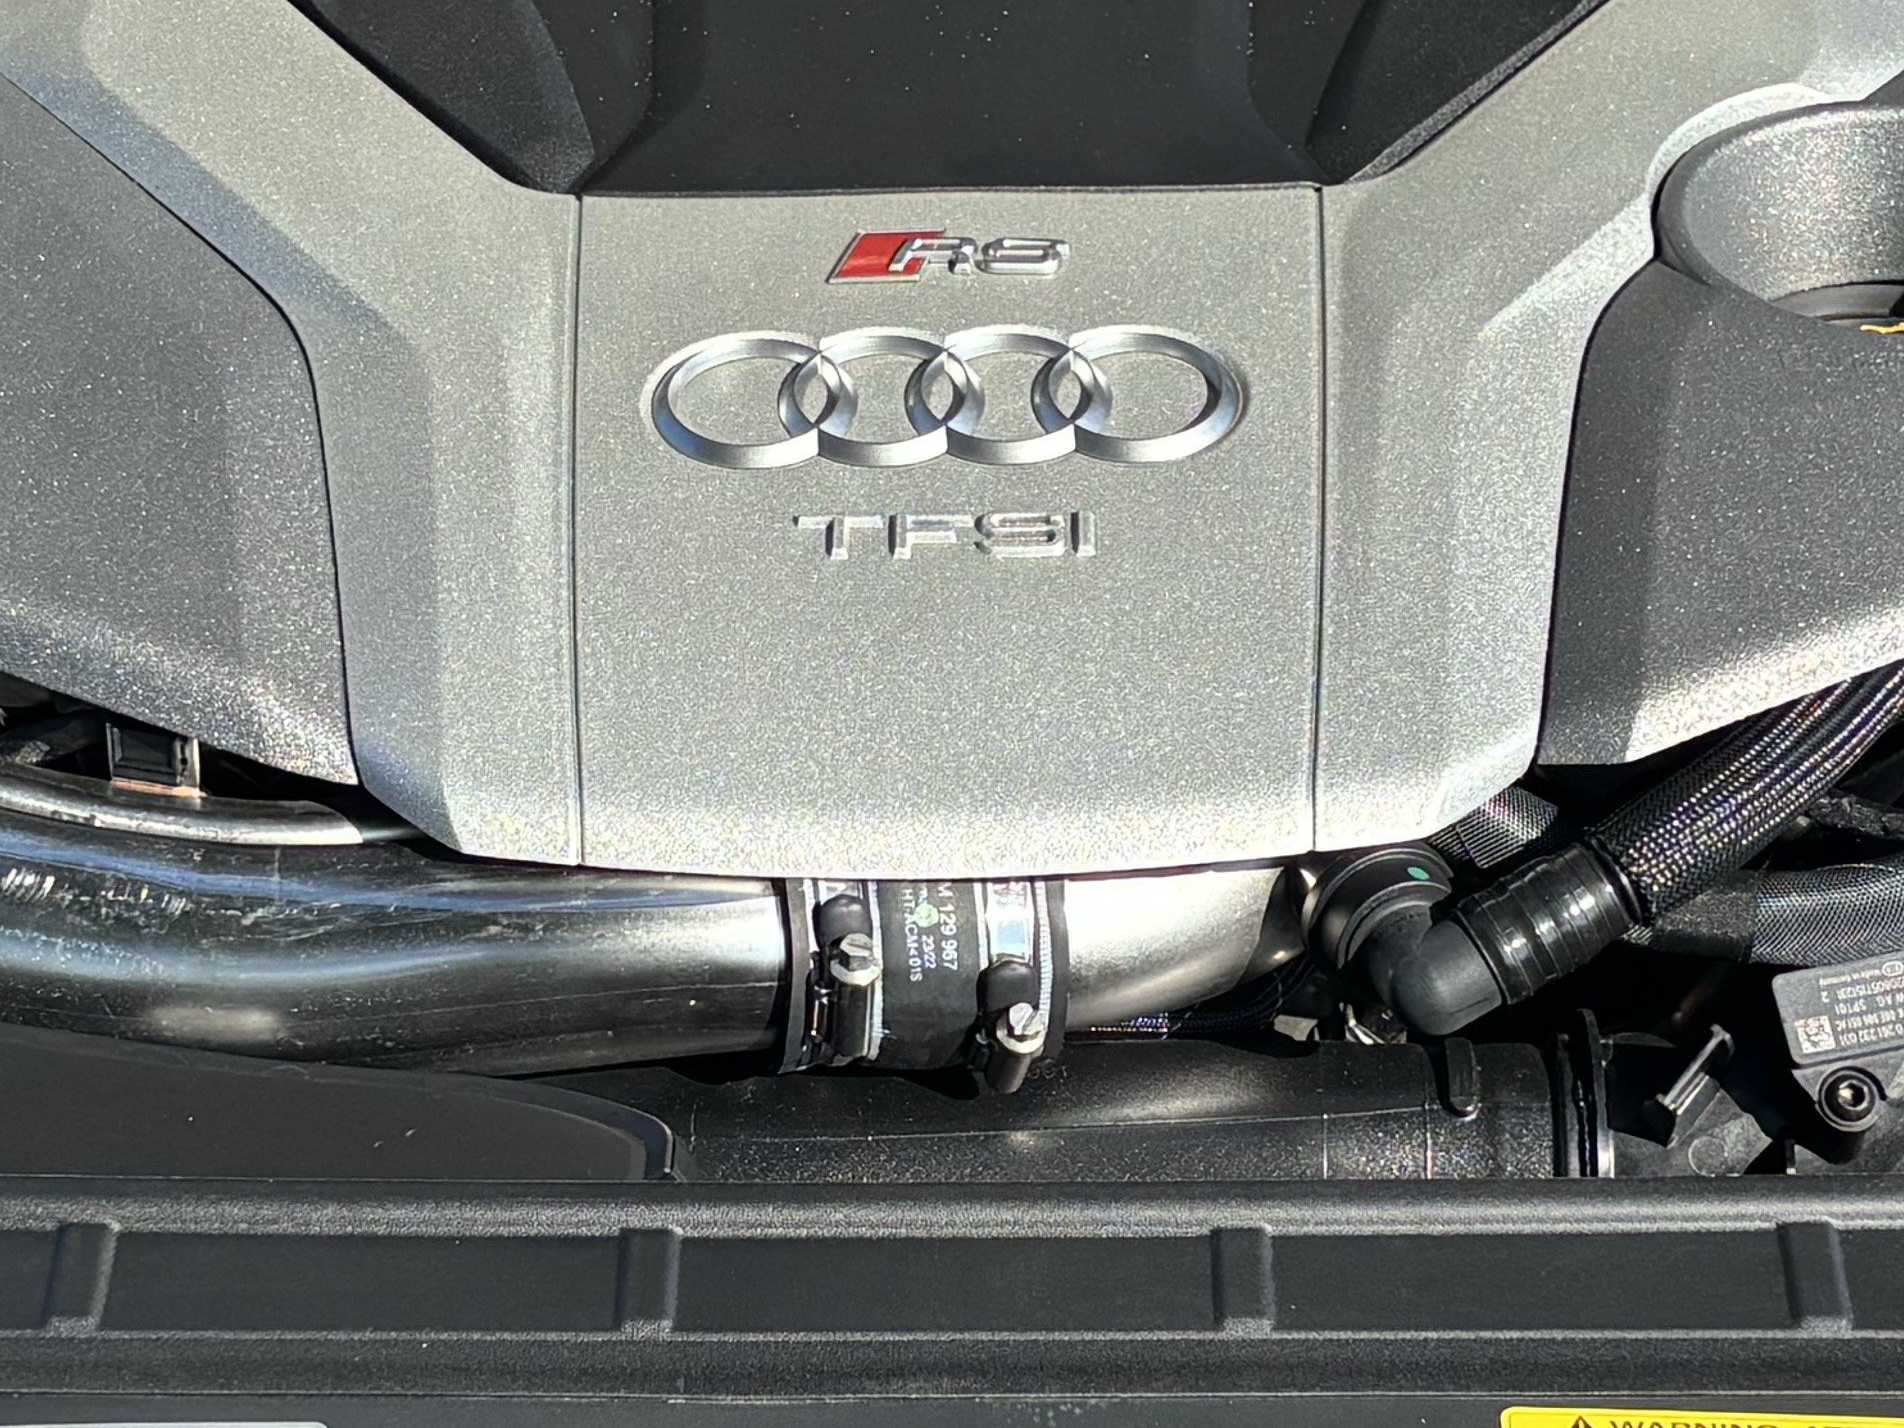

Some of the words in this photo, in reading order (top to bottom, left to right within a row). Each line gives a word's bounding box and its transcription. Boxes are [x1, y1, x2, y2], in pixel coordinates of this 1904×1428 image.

[881, 234, 1072, 278] RS
[793, 511, 1097, 561] TFSI
[939, 903, 957, 936] 129
[941, 939, 958, 971] 967
